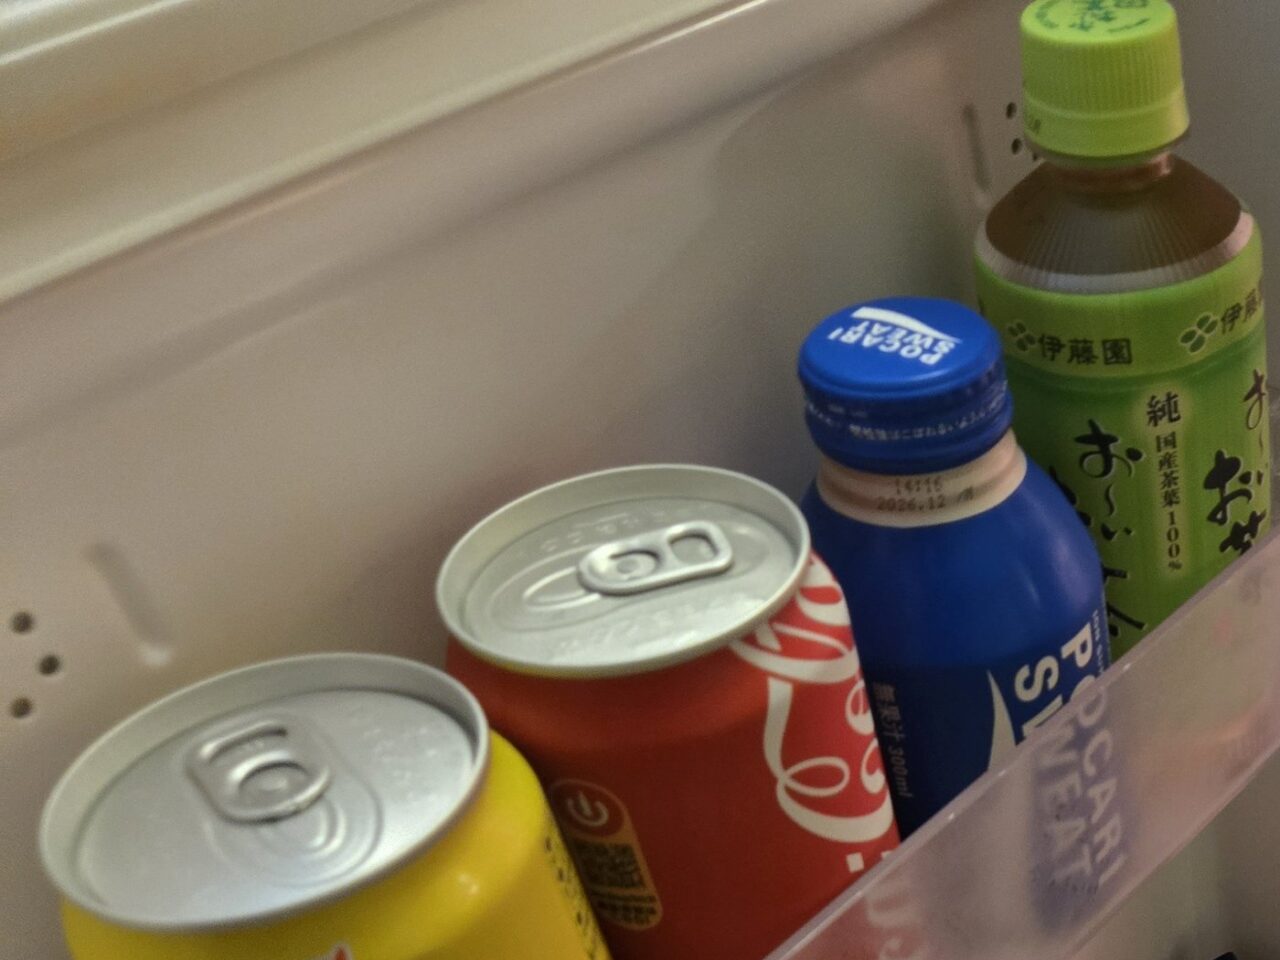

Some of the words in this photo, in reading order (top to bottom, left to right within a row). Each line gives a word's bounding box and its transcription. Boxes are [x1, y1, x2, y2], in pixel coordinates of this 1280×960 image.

[827, 325, 944, 366] POCARI
[1037, 333, 1133, 366] 伊藤園
[1146, 391, 1182, 428] 純
